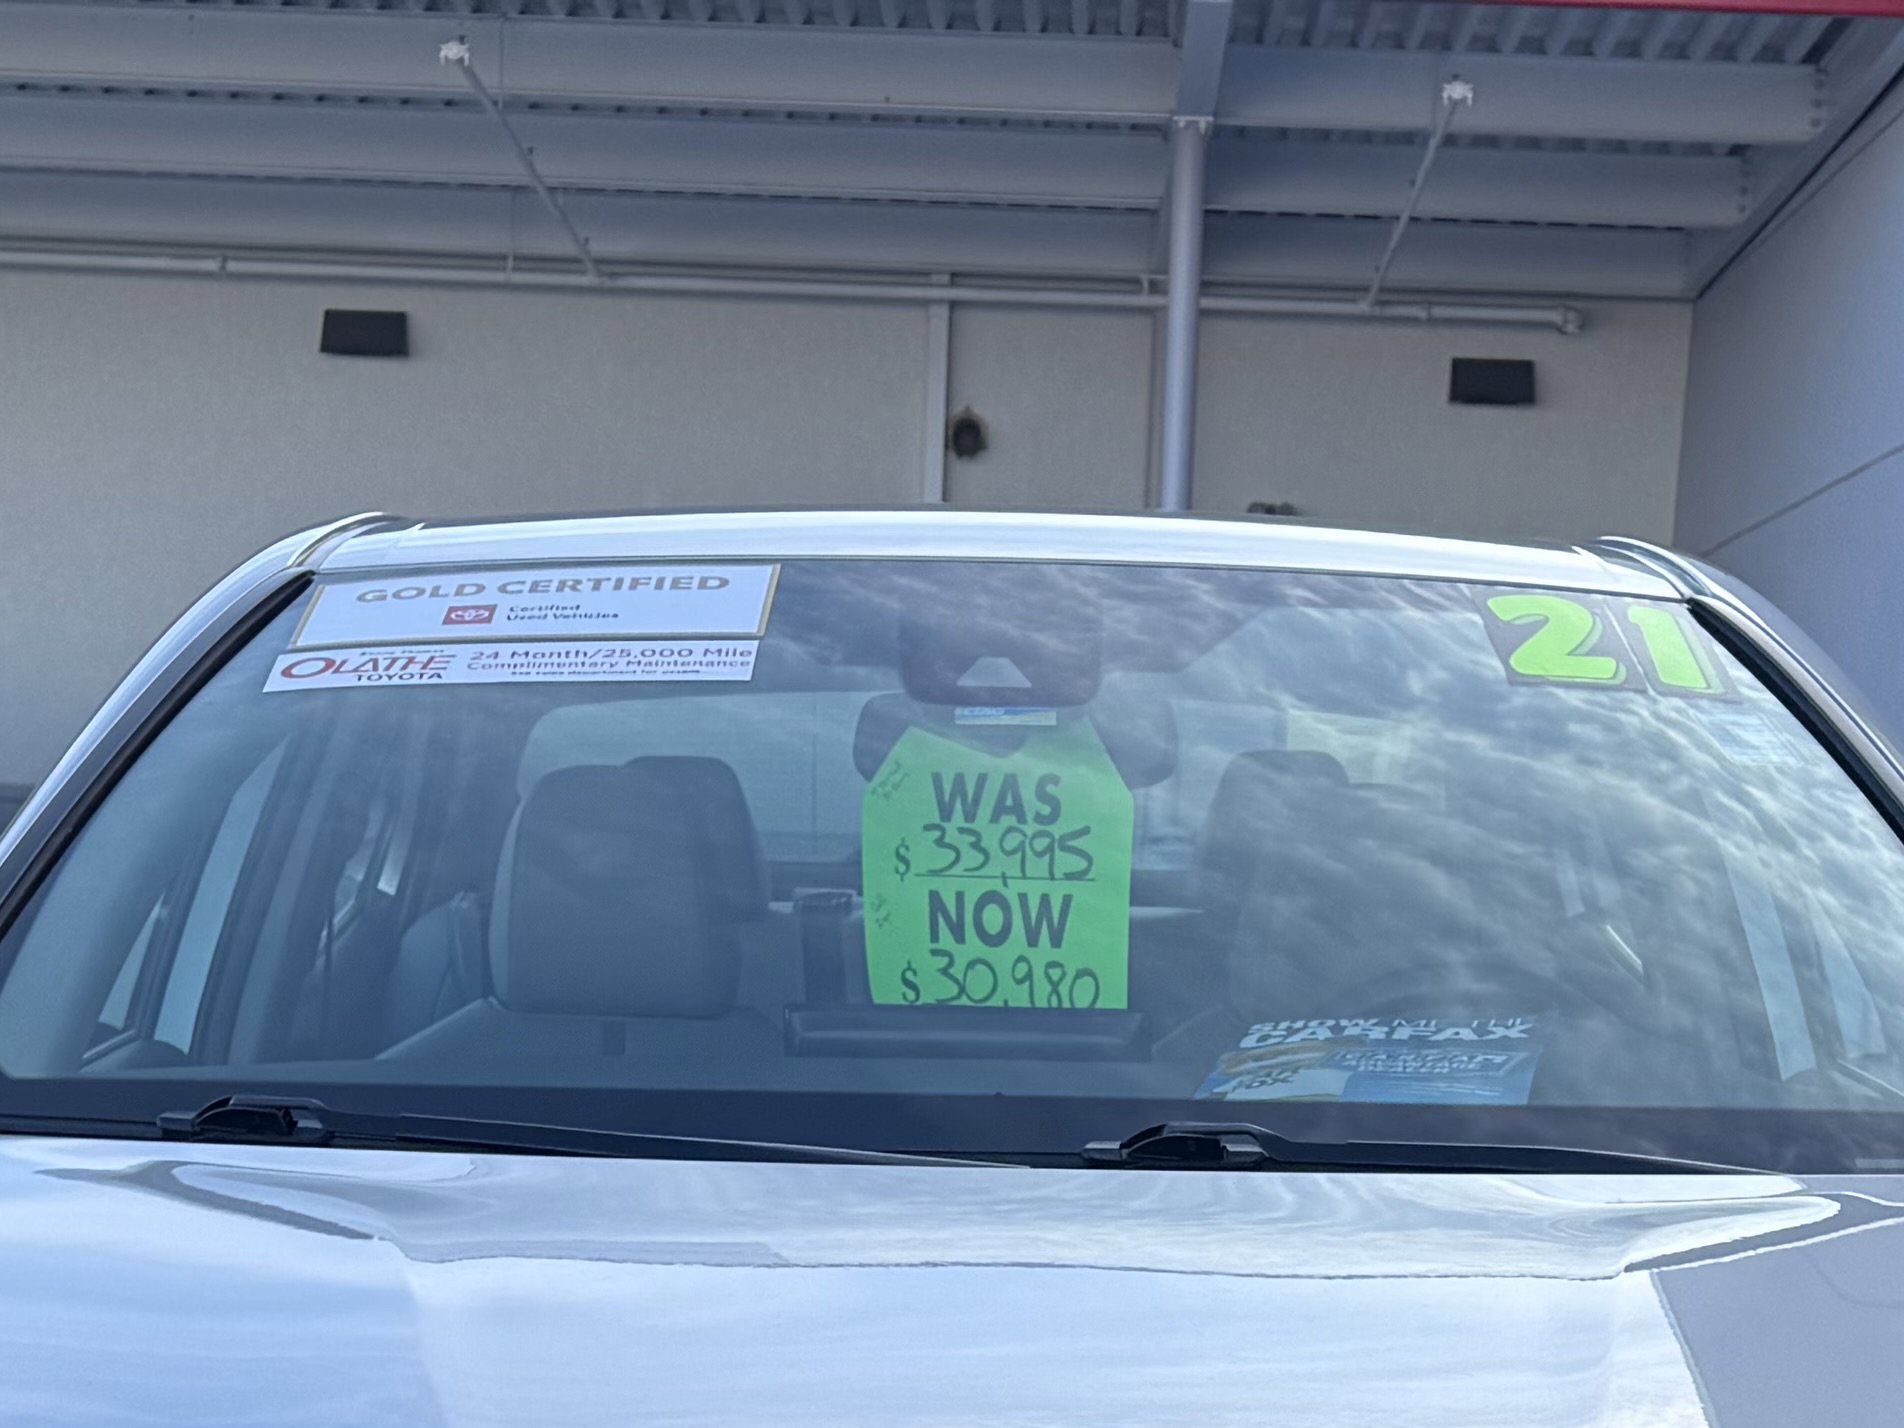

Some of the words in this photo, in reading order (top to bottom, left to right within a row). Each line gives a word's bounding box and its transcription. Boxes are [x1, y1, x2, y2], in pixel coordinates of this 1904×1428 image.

[356, 583, 486, 602] GOLD
[497, 576, 730, 594] CERTIFIED
[470, 651, 499, 661] 24
[703, 648, 753, 658] Mile
[1487, 595, 1716, 692] 21
[281, 655, 456, 679] OLATHE
[356, 672, 443, 682] TOYOTA
[466, 660, 619, 671] Complimentary
[626, 659, 751, 668] Maintenance
[931, 772, 1062, 826] WAS
[929, 890, 1074, 948] NOW
[1239, 1023, 1533, 1049] CARFAX
